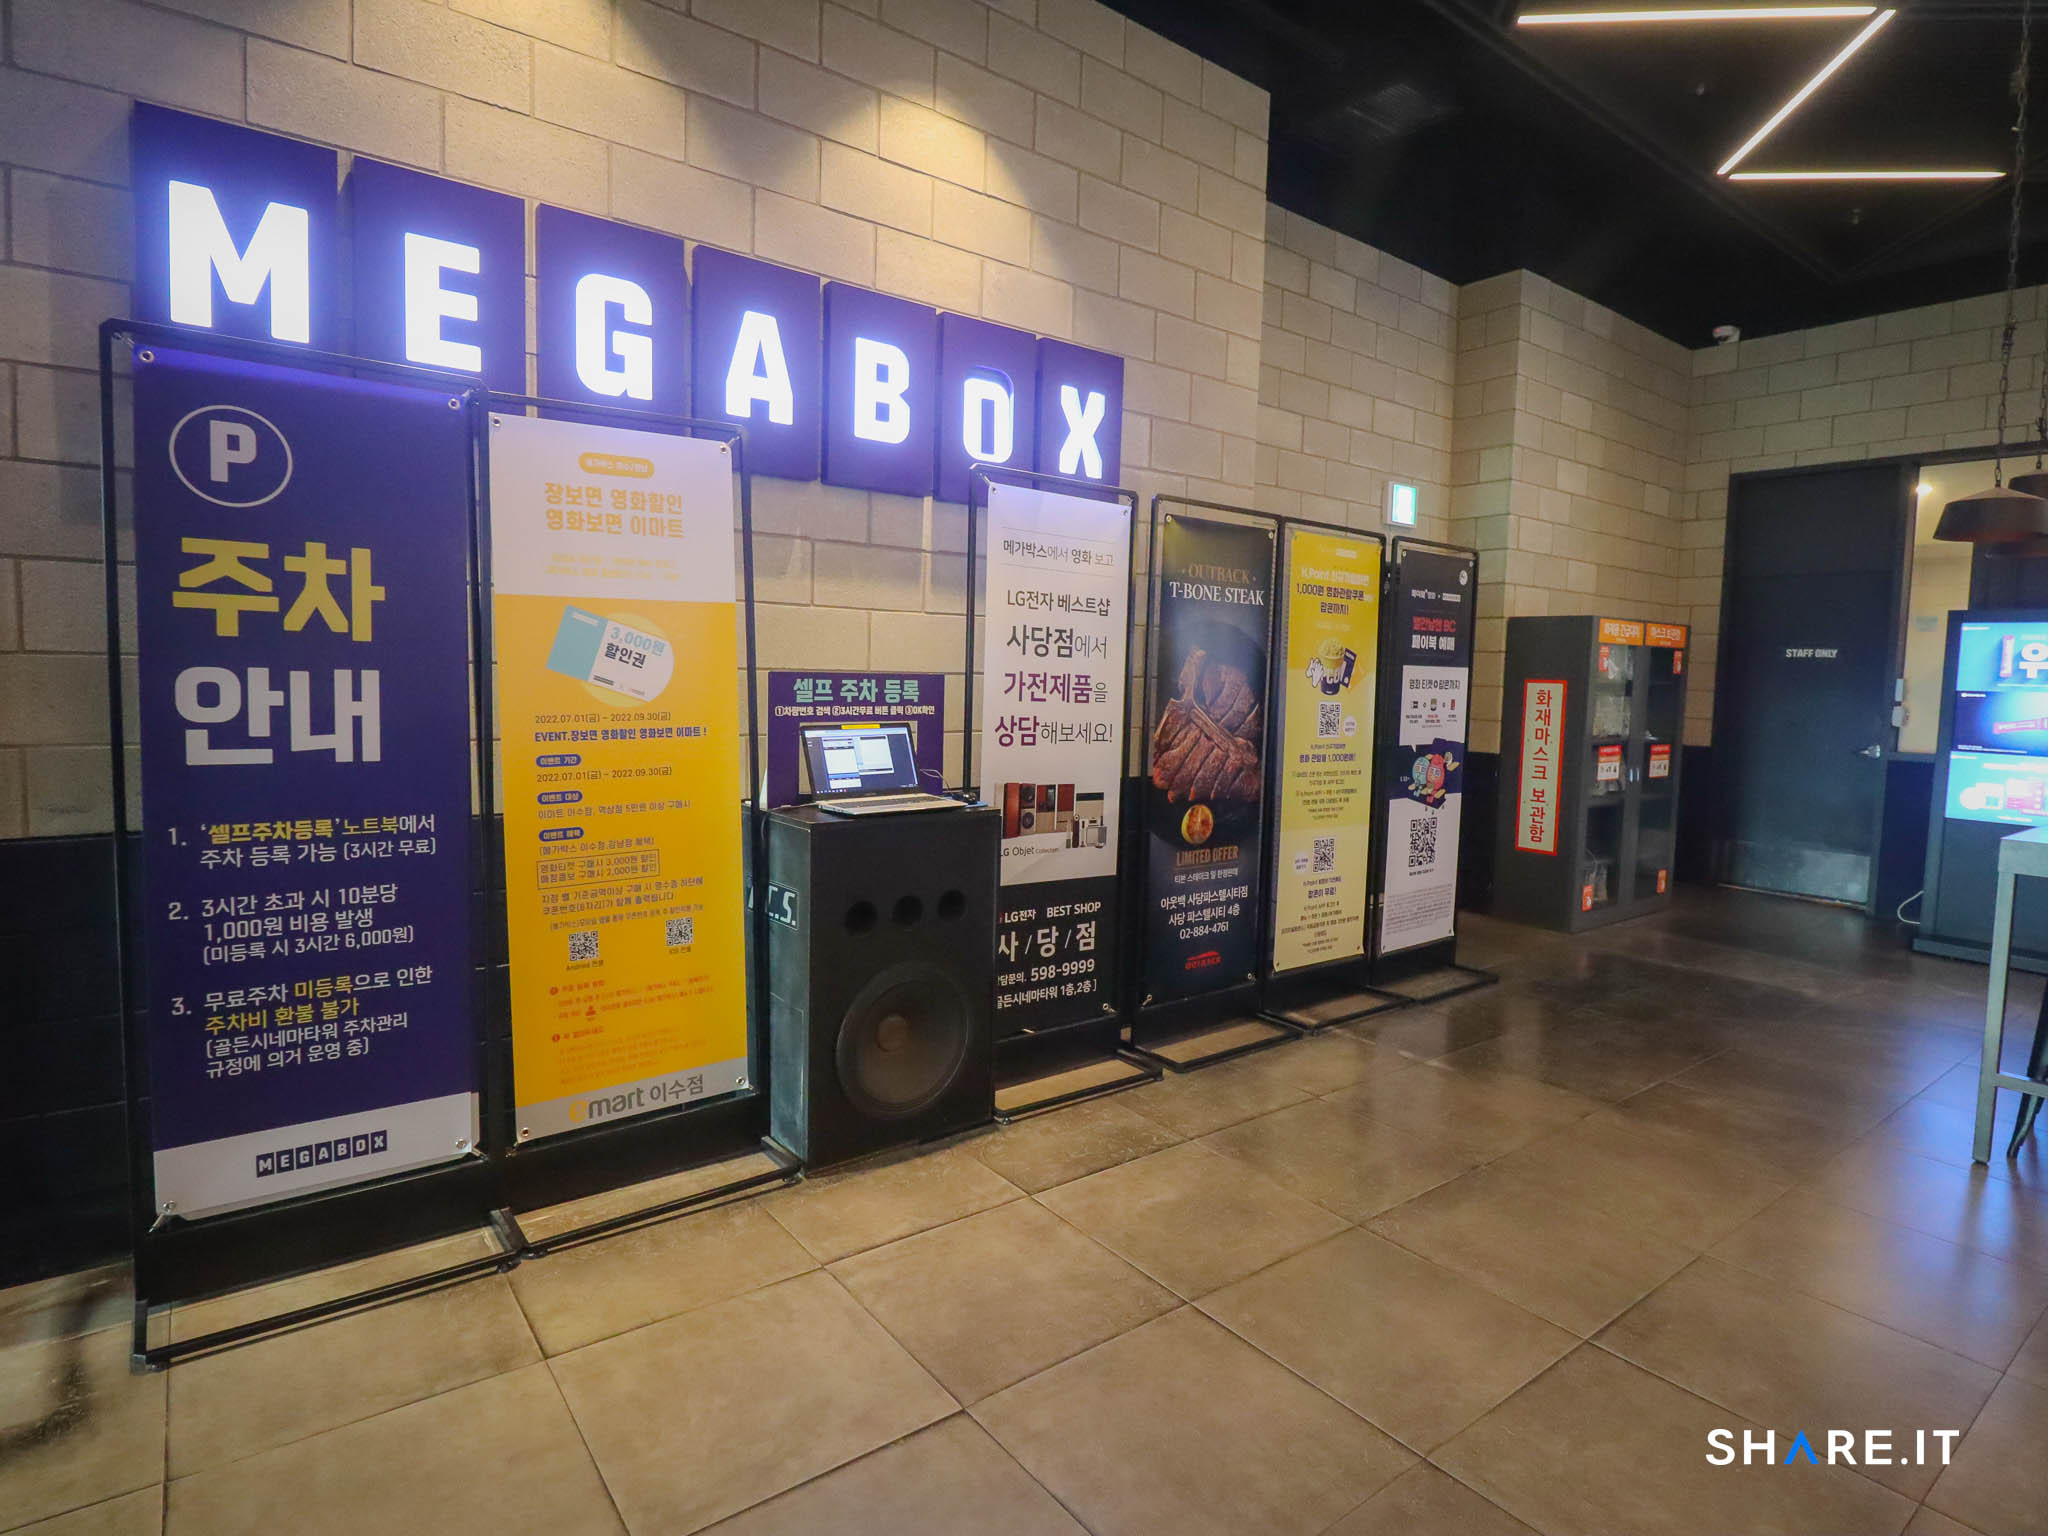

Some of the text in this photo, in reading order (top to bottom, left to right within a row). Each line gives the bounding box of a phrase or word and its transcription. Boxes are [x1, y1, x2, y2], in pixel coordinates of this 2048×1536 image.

[168, 180, 1106, 479] MEGABOX
[209, 420, 257, 483] P
[545, 482, 683, 515] 장보면 영화할인
[546, 508, 685, 539] 영화보면 이마트
[1003, 540, 1114, 567] 메가박스에서 영화 보고
[1188, 563, 1250, 584] OUTBACK
[172, 537, 386, 642] 주차
[1169, 582, 1265, 606] T-BONE STEAK
[1007, 590, 1111, 617] LG전자 베스트샵
[604, 641, 647, 669] 할인권
[1006, 624, 1108, 659] 사당점에서
[1412, 634, 1437, 650] 페이북
[1785, 649, 1838, 658] STAFF ONLY
[793, 678, 920, 703] 셀프 주차 등록
[1004, 671, 1109, 704] 가전제품을
[1410, 679, 1421, 689] 영화
[175, 667, 381, 766] 안내
[535, 711, 672, 724] 2022.07.01(금) 2022.09.30(금)
[535, 728, 598, 742] EVENT.장보면
[601, 728, 636, 740] 영화할인
[640, 727, 673, 739] 영화보면
[676, 726, 701, 737] 이마트
[536, 767, 673, 782] 2022.07.01(금) 2022.09.30(금)
[1529, 689, 1552, 843] 화재마스크 보관함
[168, 827, 187, 846] 1.
[342, 814, 436, 836] 노트북에서
[200, 848, 243, 870] 주차
[250, 845, 292, 867] 등록
[297, 843, 337, 863] 가능
[1176, 845, 1240, 867] LIMITED OFFER
[168, 883, 399, 921] 2. 3시간 초과 시 10분당
[1160, 885, 1248, 911] 아웃백 사당파스텔시티점
[204, 908, 374, 944] 1,000원 비용 발생
[1004, 901, 1101, 924] LG전자 BEST SHOP
[1168, 903, 1240, 926] 사당 파스텔시티 4층
[1179, 921, 1229, 940] 02-884-4761
[271, 939, 289, 957] 시
[295, 933, 340, 954] 3시간
[1030, 958, 1095, 983] 598-9999
[171, 965, 433, 1017] 3. 무료주차 미등록으로 인한
[205, 997, 360, 1036] 주차비 환불 불가
[343, 1012, 409, 1037] 주차관리
[206, 1054, 261, 1080] 규정에
[266, 1047, 302, 1068] 의거
[307, 1042, 342, 1063] 운영
[569, 1074, 705, 1123] emart 이수점
[257, 1132, 387, 1176] MEGABOX
